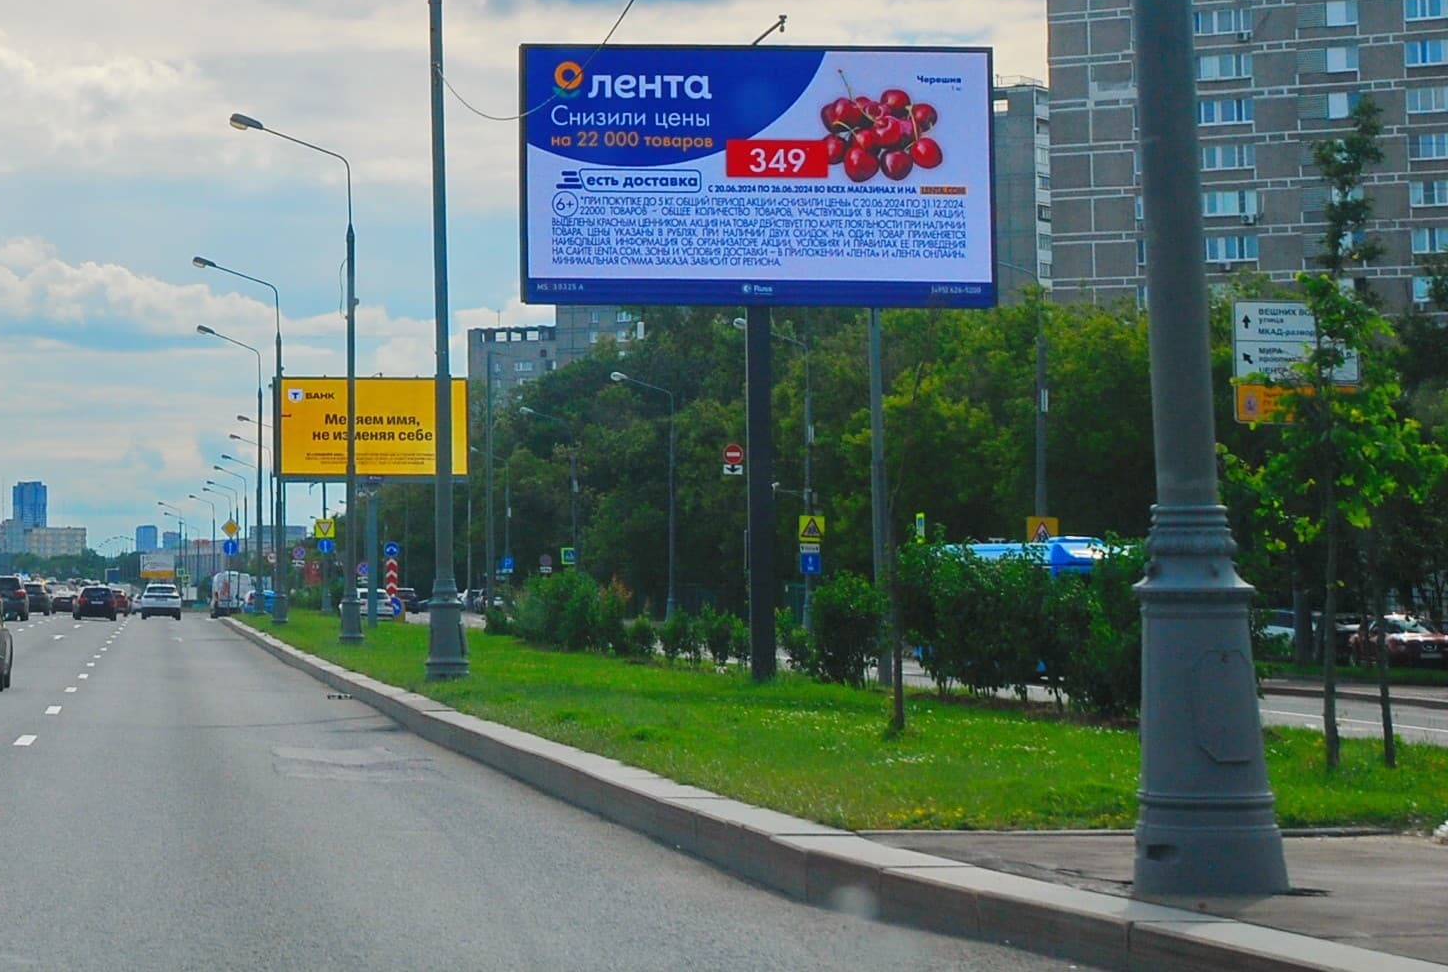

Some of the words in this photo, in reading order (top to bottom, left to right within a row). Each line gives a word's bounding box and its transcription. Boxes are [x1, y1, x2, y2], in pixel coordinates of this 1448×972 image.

[588, 74, 712, 99] лента
[551, 104, 646, 126] Снизили
[655, 113, 710, 128] цены
[551, 135, 572, 147] на
[577, 131, 599, 147] 22
[604, 131, 639, 147] 000
[644, 136, 714, 152] товаров
[586, 176, 619, 186] есть
[622, 176, 698, 188] доставка
[758, 185, 769, 193] ПО
[827, 186, 846, 194] ВСЕХ
[847, 186, 896, 194] МАГАЗИНАХ
[555, 198, 573, 211] 6+
[305, 392, 335, 400] БАНК
[324, 413, 383, 425] Меяем
[386, 415, 420, 427] имя,
[312, 431, 331, 440] не
[398, 429, 433, 440] себе
